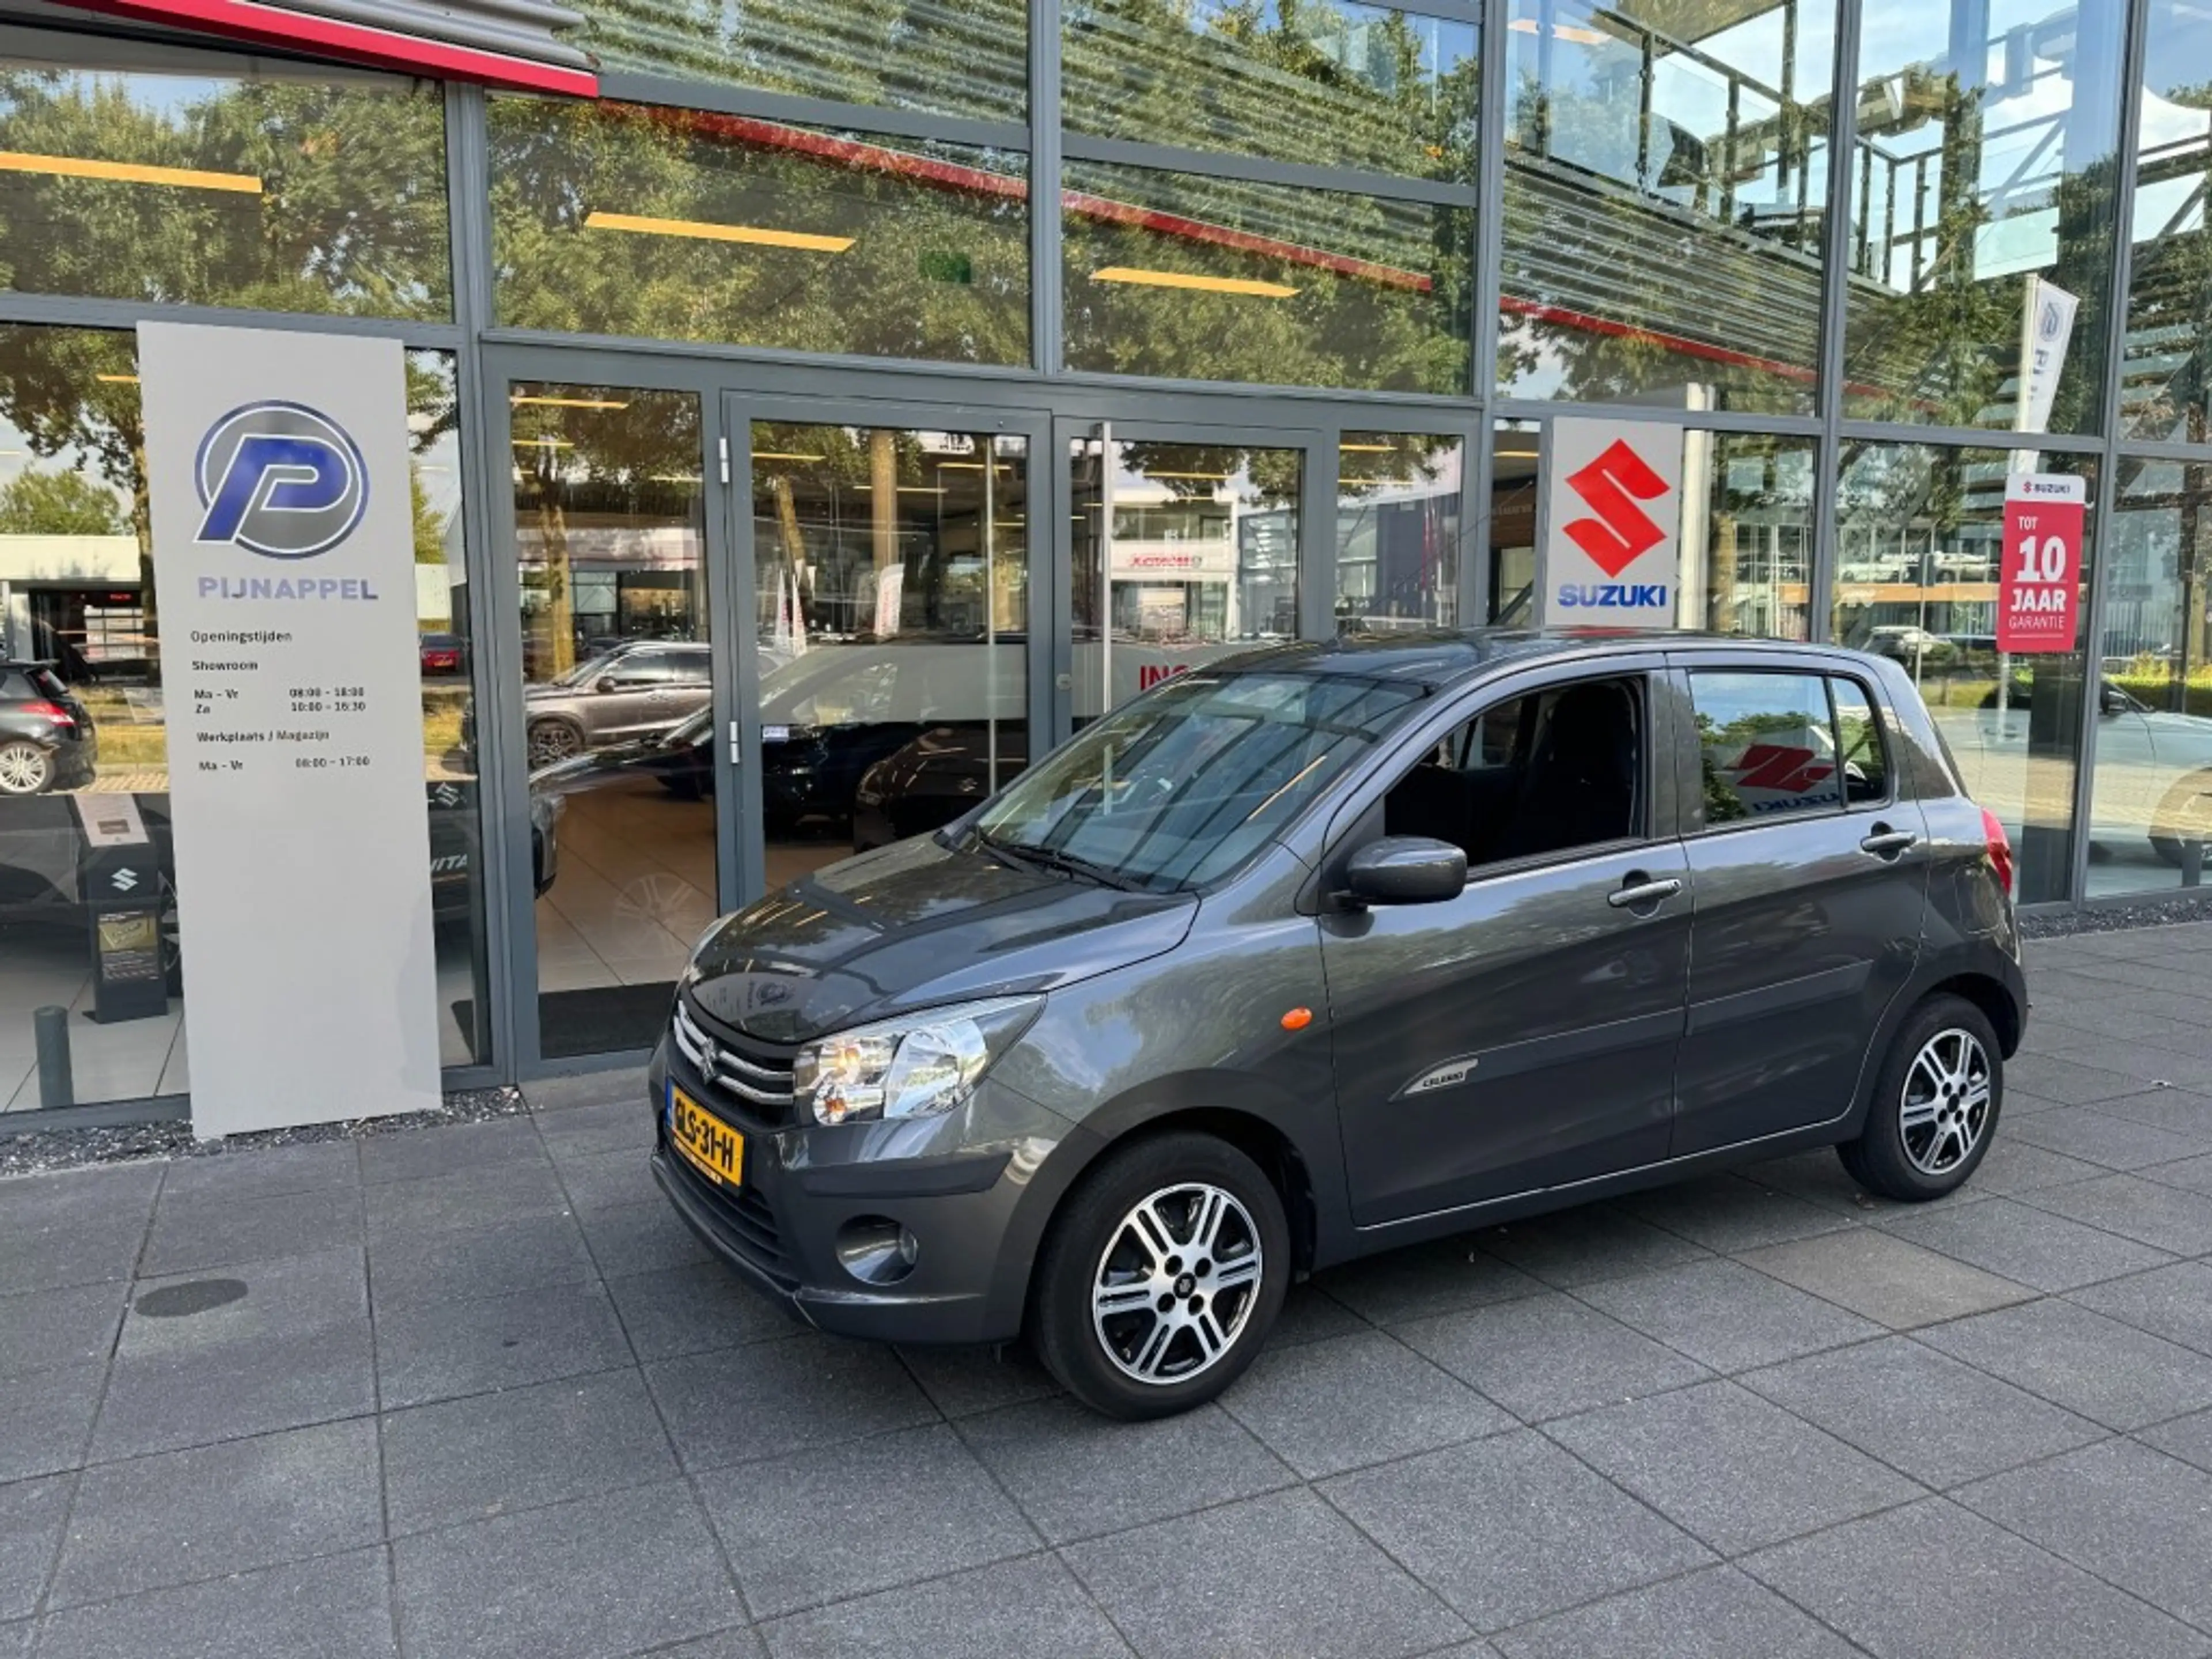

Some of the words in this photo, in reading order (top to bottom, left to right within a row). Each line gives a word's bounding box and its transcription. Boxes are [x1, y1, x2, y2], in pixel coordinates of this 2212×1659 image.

[2034, 483, 2071, 494] SUZUKI
[2018, 516, 2039, 530] TOT
[2017, 536, 2066, 582] 10
[197, 577, 378, 600] PIJNAPPEL
[1558, 584, 1666, 608] SUZUKI
[2010, 588, 2067, 612] JAAR
[2009, 616, 2065, 630] GARANTIE
[190, 630, 292, 644] Openingstijden
[192, 660, 258, 671] Showroom
[194, 690, 213, 699] Ma
[225, 690, 239, 699] Vr
[195, 704, 211, 714] Za
[196, 732, 264, 744] Werkplaats
[276, 730, 329, 742] Magazijn
[199, 761, 217, 770] Ma
[230, 760, 243, 770] Vr
